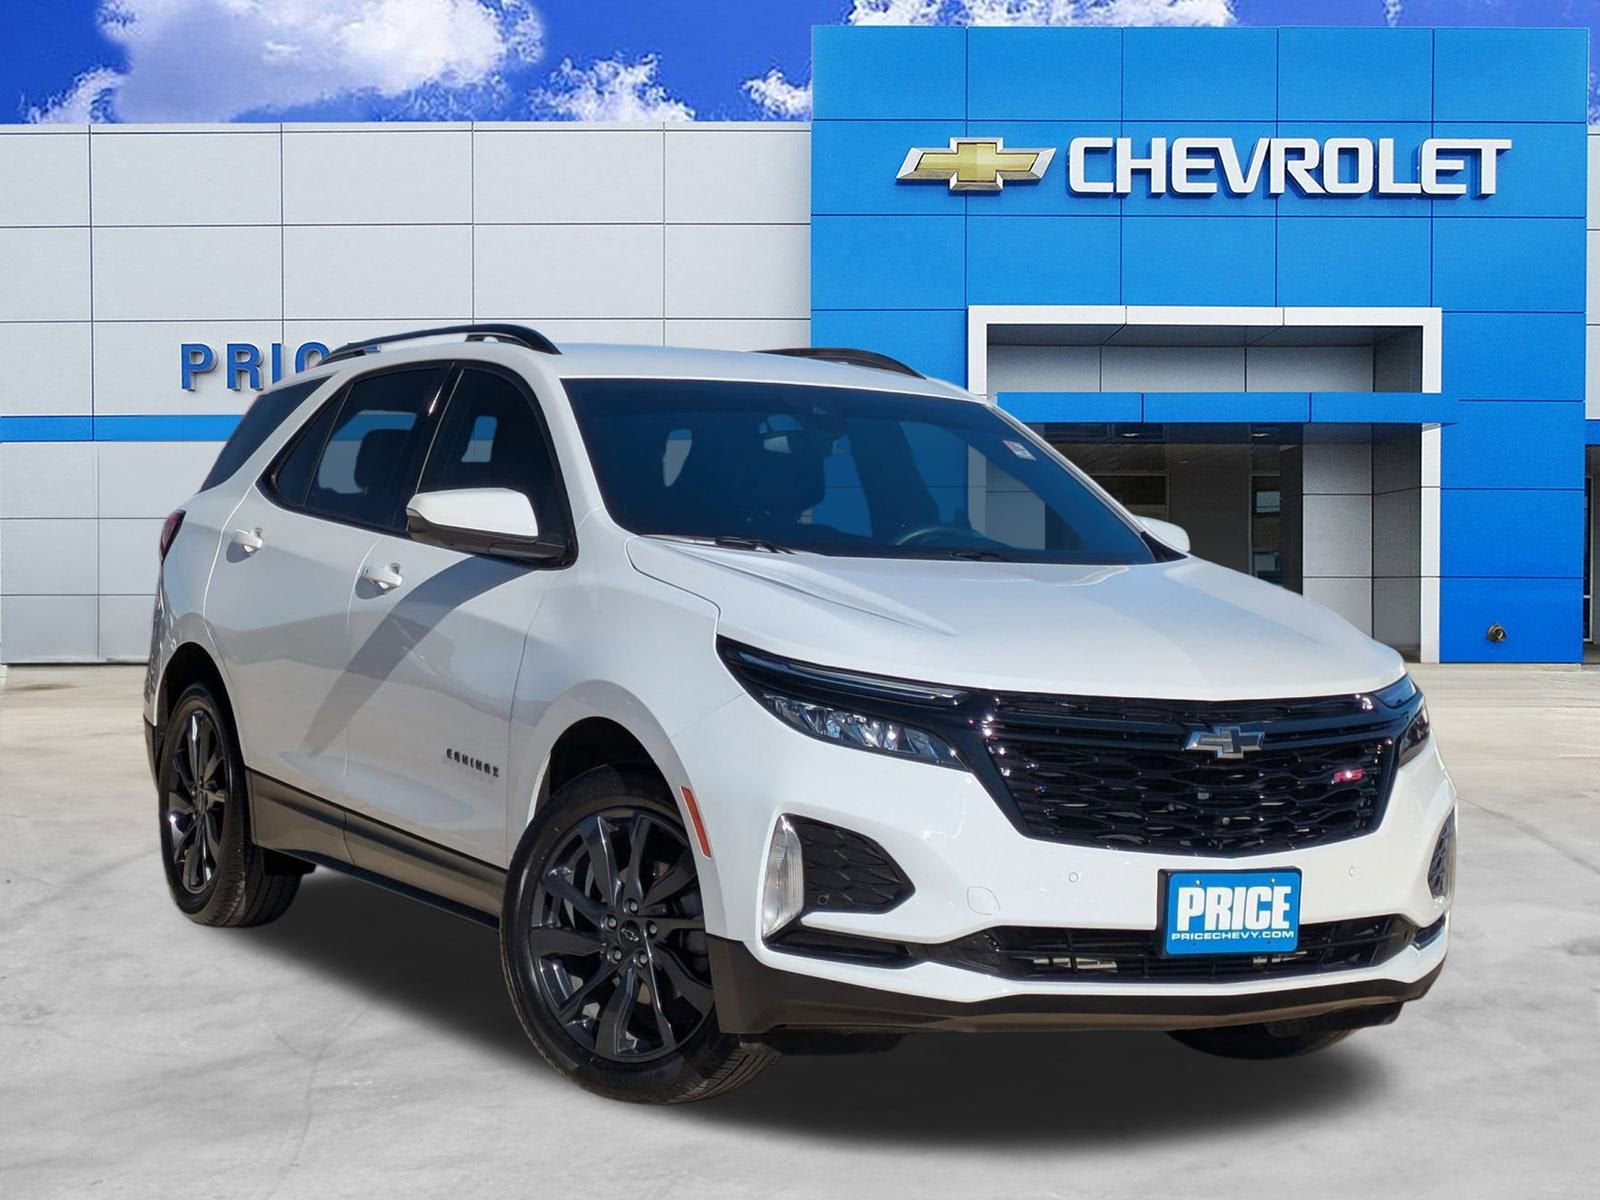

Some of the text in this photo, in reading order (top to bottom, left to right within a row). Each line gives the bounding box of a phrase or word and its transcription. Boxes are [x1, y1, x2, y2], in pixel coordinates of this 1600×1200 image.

[1068, 137, 1512, 196] CHEVROLET
[181, 342, 381, 391] PRIC
[446, 748, 499, 778] EQUINOX
[1176, 885, 1292, 932] PRICE
[1171, 930, 1295, 941] PRICECHEVY.COM
